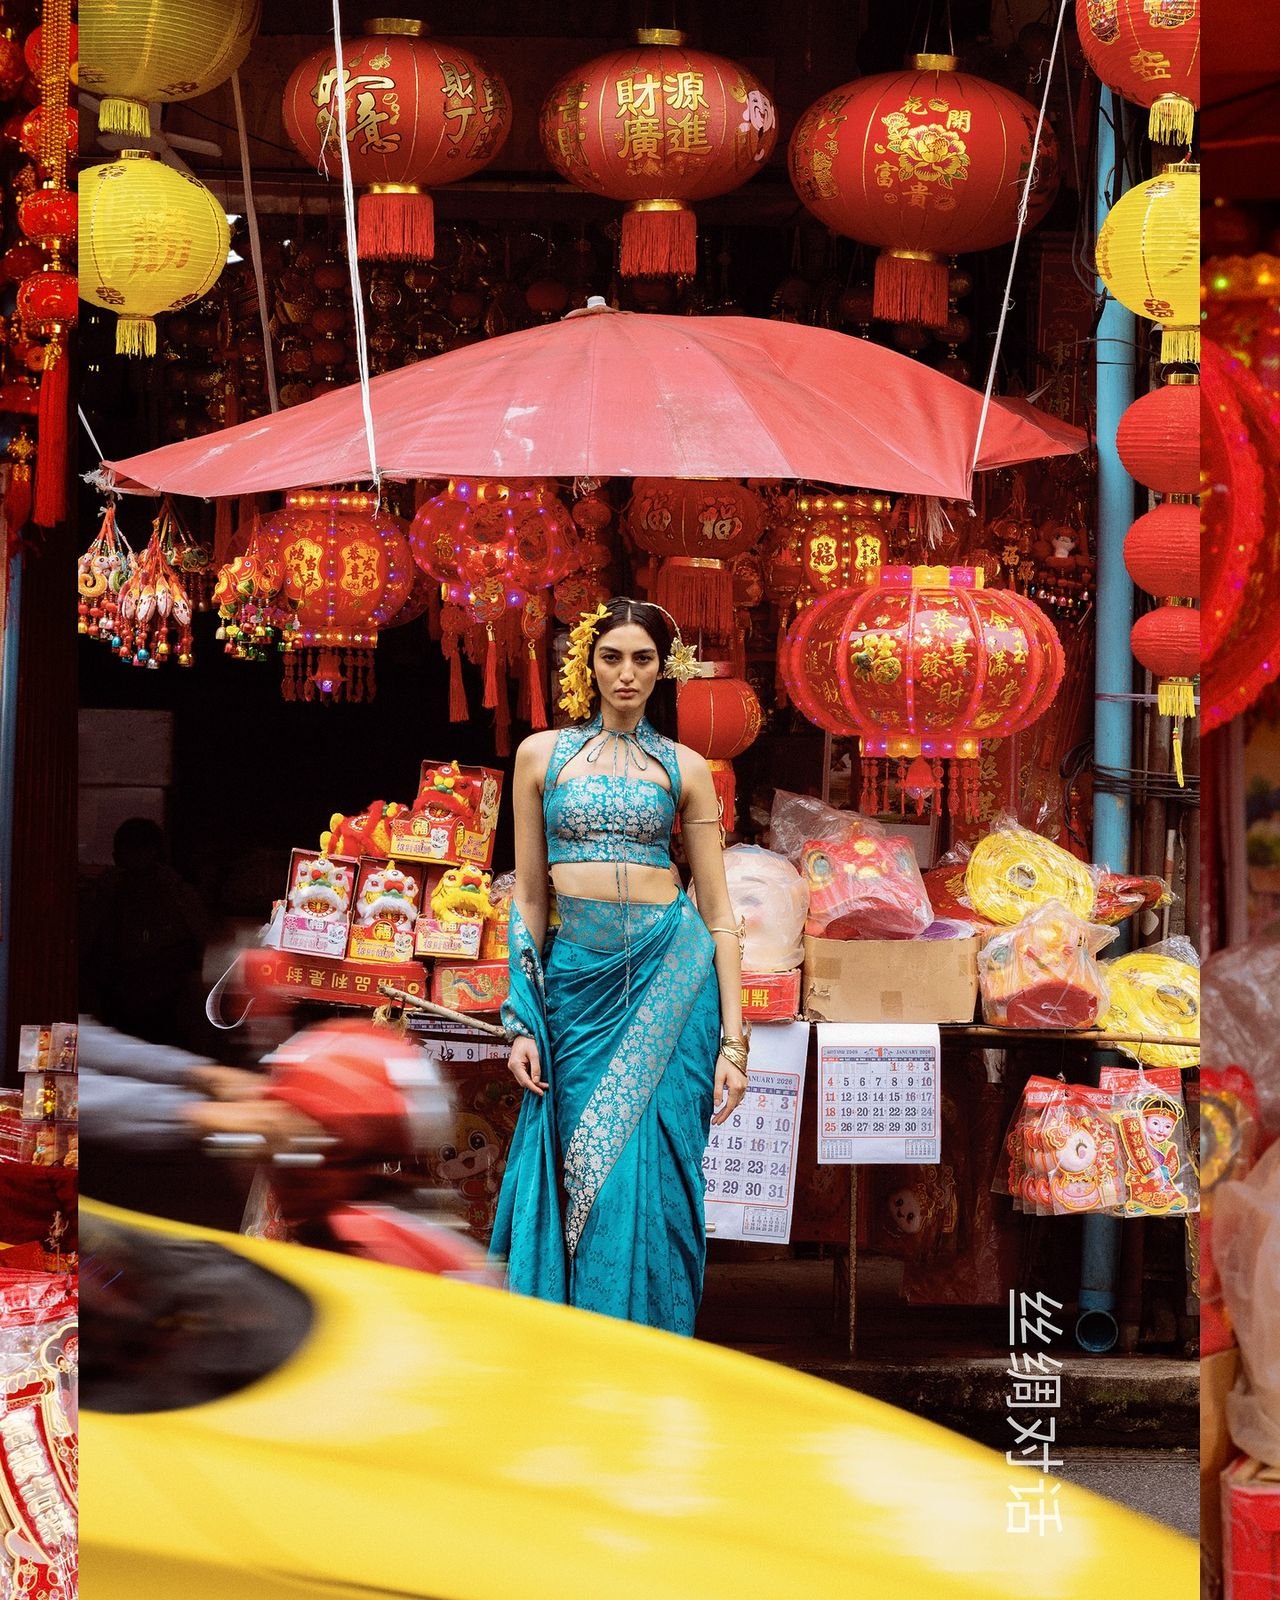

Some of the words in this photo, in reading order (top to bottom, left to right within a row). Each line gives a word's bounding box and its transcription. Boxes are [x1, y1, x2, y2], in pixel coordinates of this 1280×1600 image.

[615, 71, 709, 118] 財源
[617, 113, 713, 162] 廣進
[467, 1048, 475, 1060] 9
[891, 1063, 897, 1072] 1
[907, 1063, 914, 1071] 2
[924, 1063, 929, 1071] 3
[828, 1077, 833, 1086] 4
[844, 1078, 849, 1086] 5
[860, 1077, 865, 1086] 6
[876, 1077, 881, 1086] 7
[892, 1077, 897, 1086] 8
[908, 1077, 913, 1086] 9
[922, 1077, 932, 1086] 10
[758, 1096, 767, 1108] 2
[781, 1097, 788, 1109] 3
[826, 1092, 835, 1101] 11
[841, 1092, 852, 1101] 12
[858, 1092, 867, 1101] 13
[874, 1093, 884, 1101] 14
[890, 1093, 900, 1101] 15
[906, 1092, 915, 1101] 16
[922, 1092, 932, 1101] 17
[826, 1107, 835, 1116] 18
[842, 1108, 851, 1116] 19
[857, 1107, 868, 1116] 20
[873, 1108, 884, 1116] 21
[889, 1107, 900, 1116] 22
[905, 1107, 916, 1116] 23
[921, 1107, 932, 1116] 24
[733, 1115, 741, 1127] 8
[756, 1117, 764, 1129] 9
[775, 1119, 790, 1132] 10
[825, 1122, 836, 1131] 25
[841, 1123, 852, 1131] 26
[857, 1123, 868, 1131] 27
[873, 1122, 884, 1131] 28
[889, 1122, 900, 1131] 29
[905, 1122, 916, 1131] 30
[921, 1122, 931, 1131] 31
[727, 1137, 742, 1150] 15
[750, 1139, 765, 1152] 16
[773, 1141, 788, 1153] 17
[1092, 1120, 1117, 1186] 大吉大利
[703, 1157, 717, 1170] 21
[725, 1159, 740, 1172] 22
[747, 1160, 763, 1174] 23
[770, 1163, 786, 1176] 24
[722, 1181, 738, 1194] 29
[746, 1182, 761, 1196] 30
[769, 1184, 784, 1198] 31
